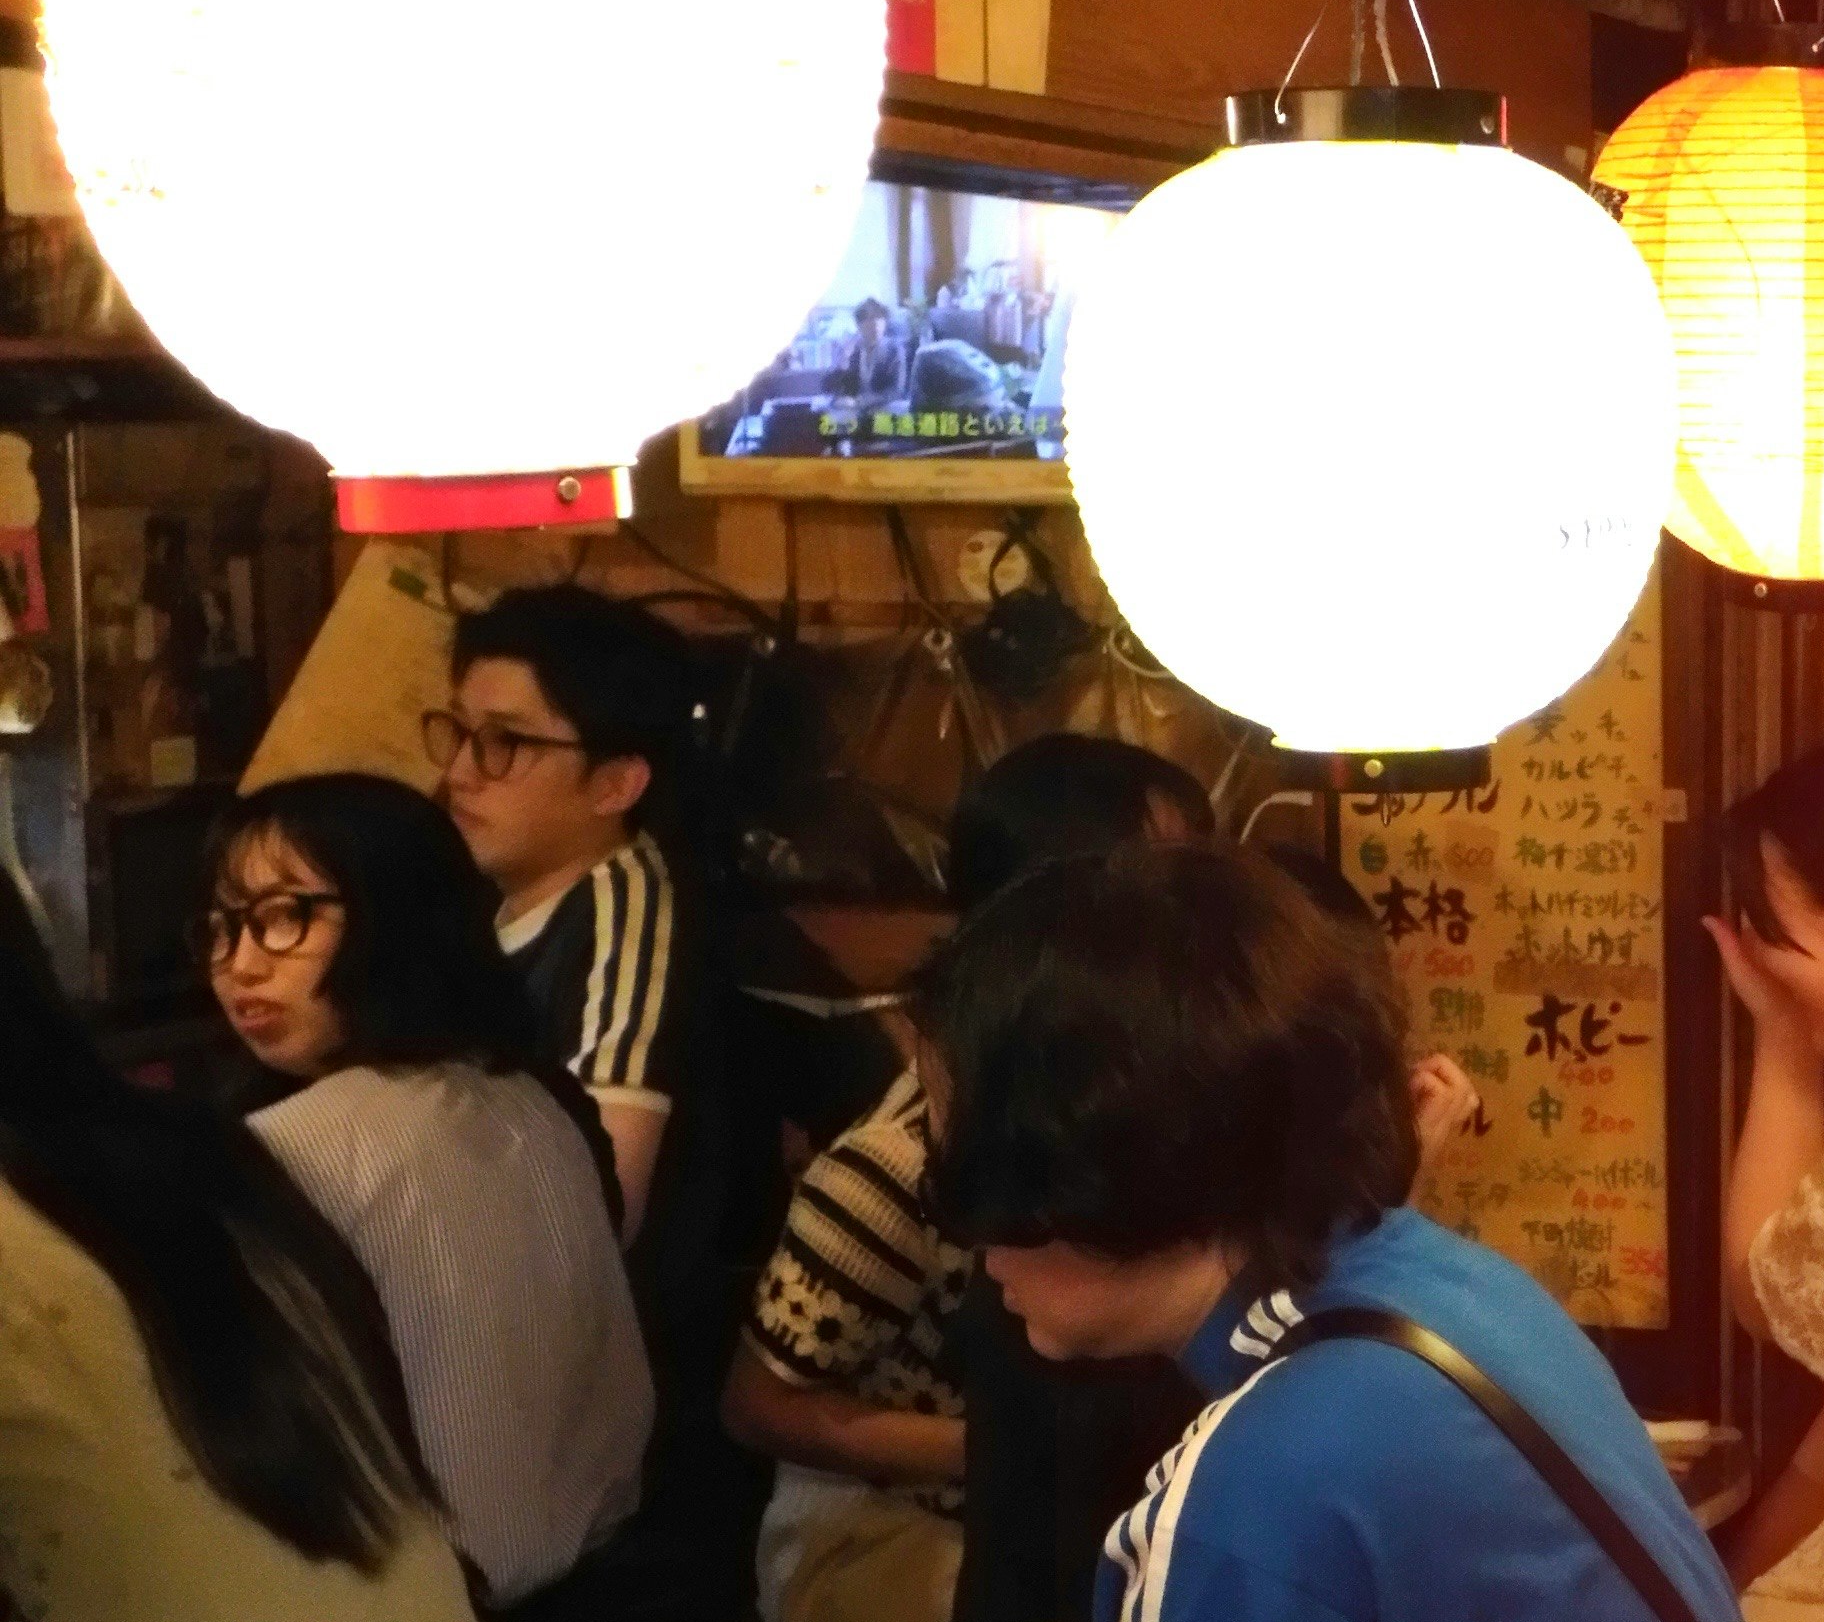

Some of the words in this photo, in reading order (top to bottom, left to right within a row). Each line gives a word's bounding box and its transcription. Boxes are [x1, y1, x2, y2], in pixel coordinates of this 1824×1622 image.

[1525, 989, 1652, 1063] ホッピー
[1527, 1085, 1564, 1139] 中
[1579, 1106, 1636, 1135] 200
